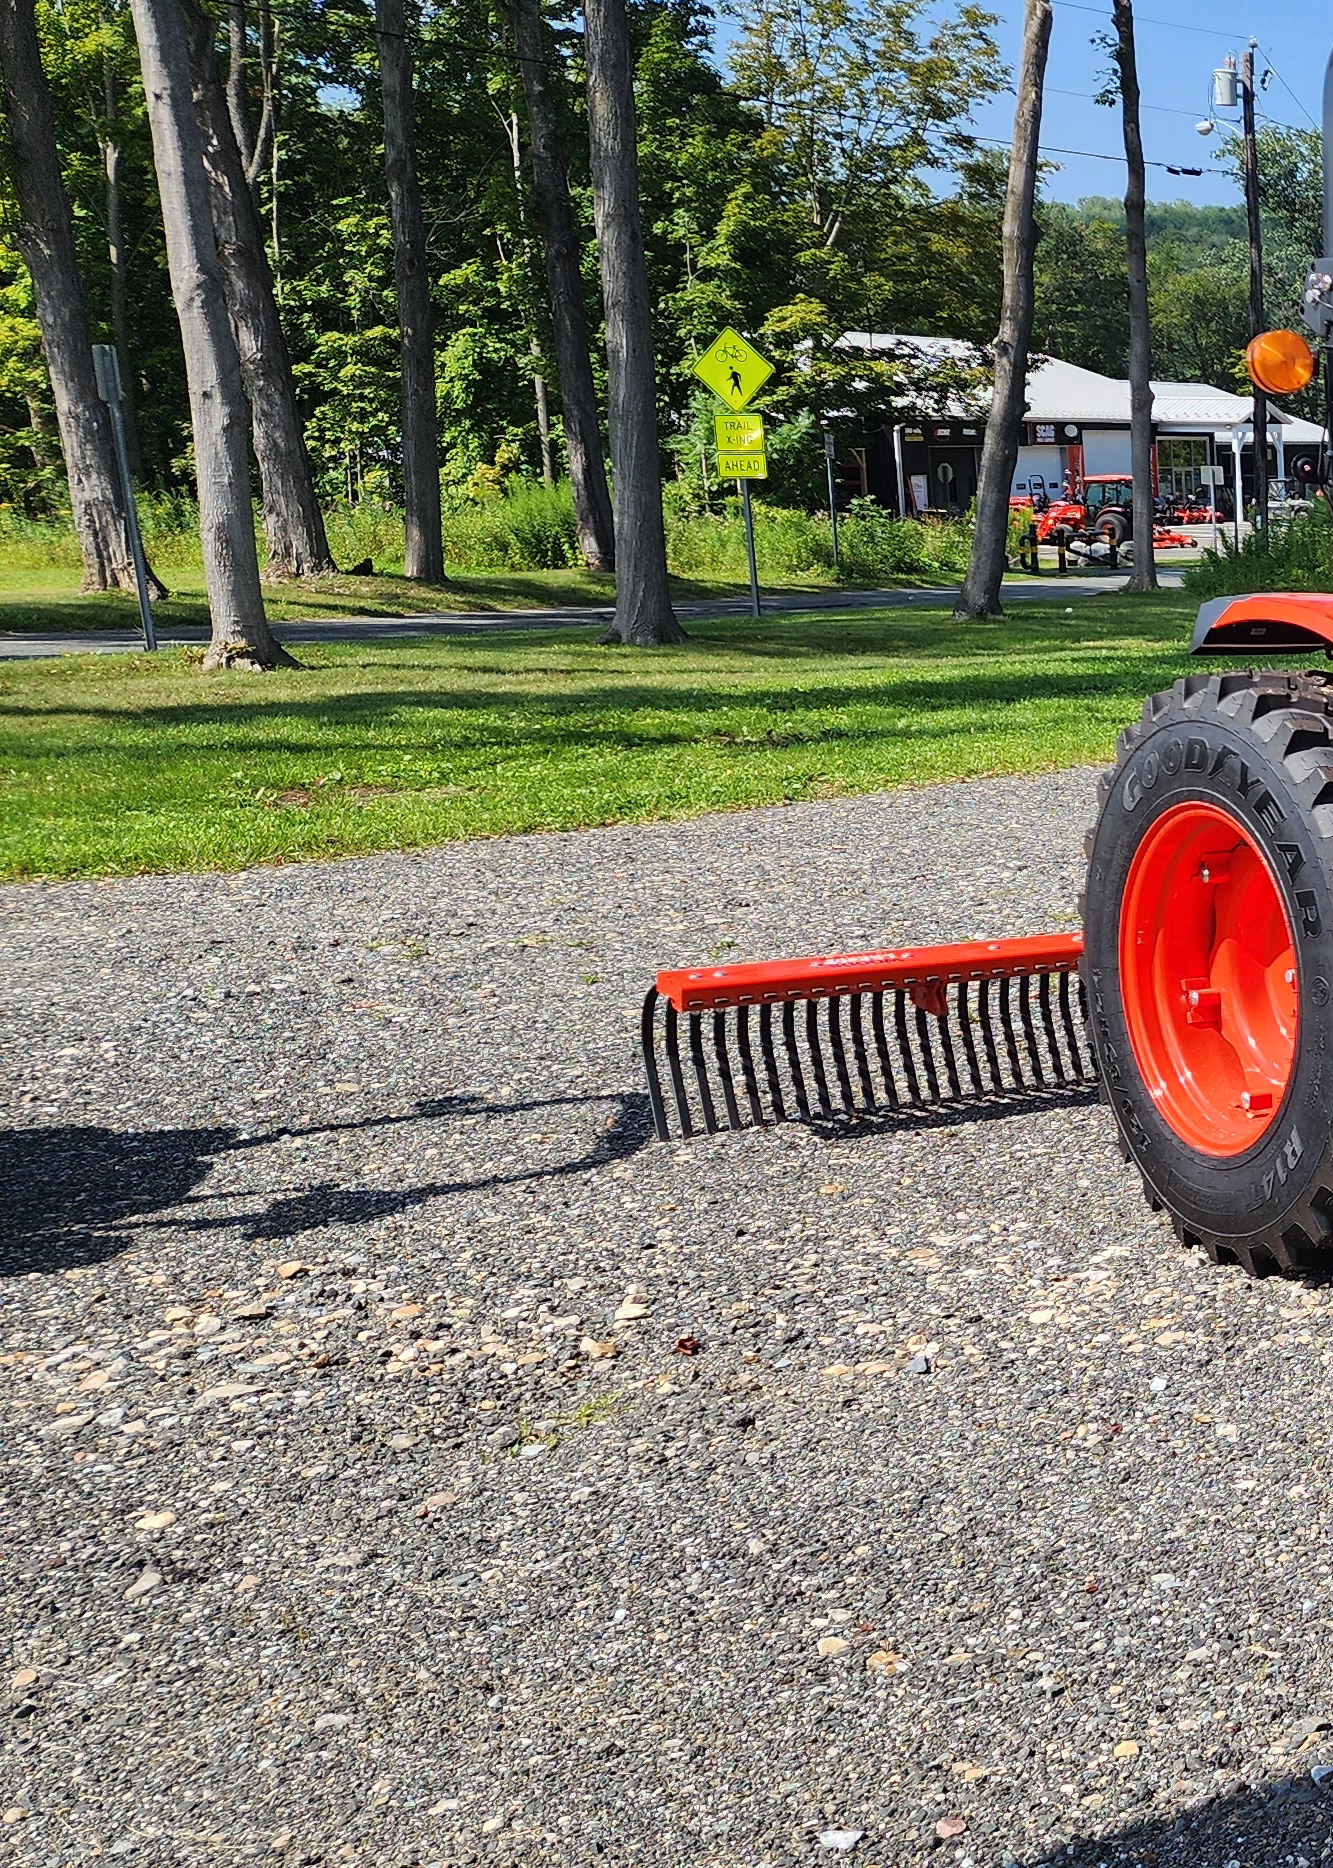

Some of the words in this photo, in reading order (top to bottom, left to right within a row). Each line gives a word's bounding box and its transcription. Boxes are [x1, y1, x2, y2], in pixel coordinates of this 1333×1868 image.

[724, 422, 752, 431] TRAIL
[726, 435, 753, 445] X-ING
[725, 460, 760, 471] AHEAD
[1122, 737, 1322, 939] GOODYEAR
